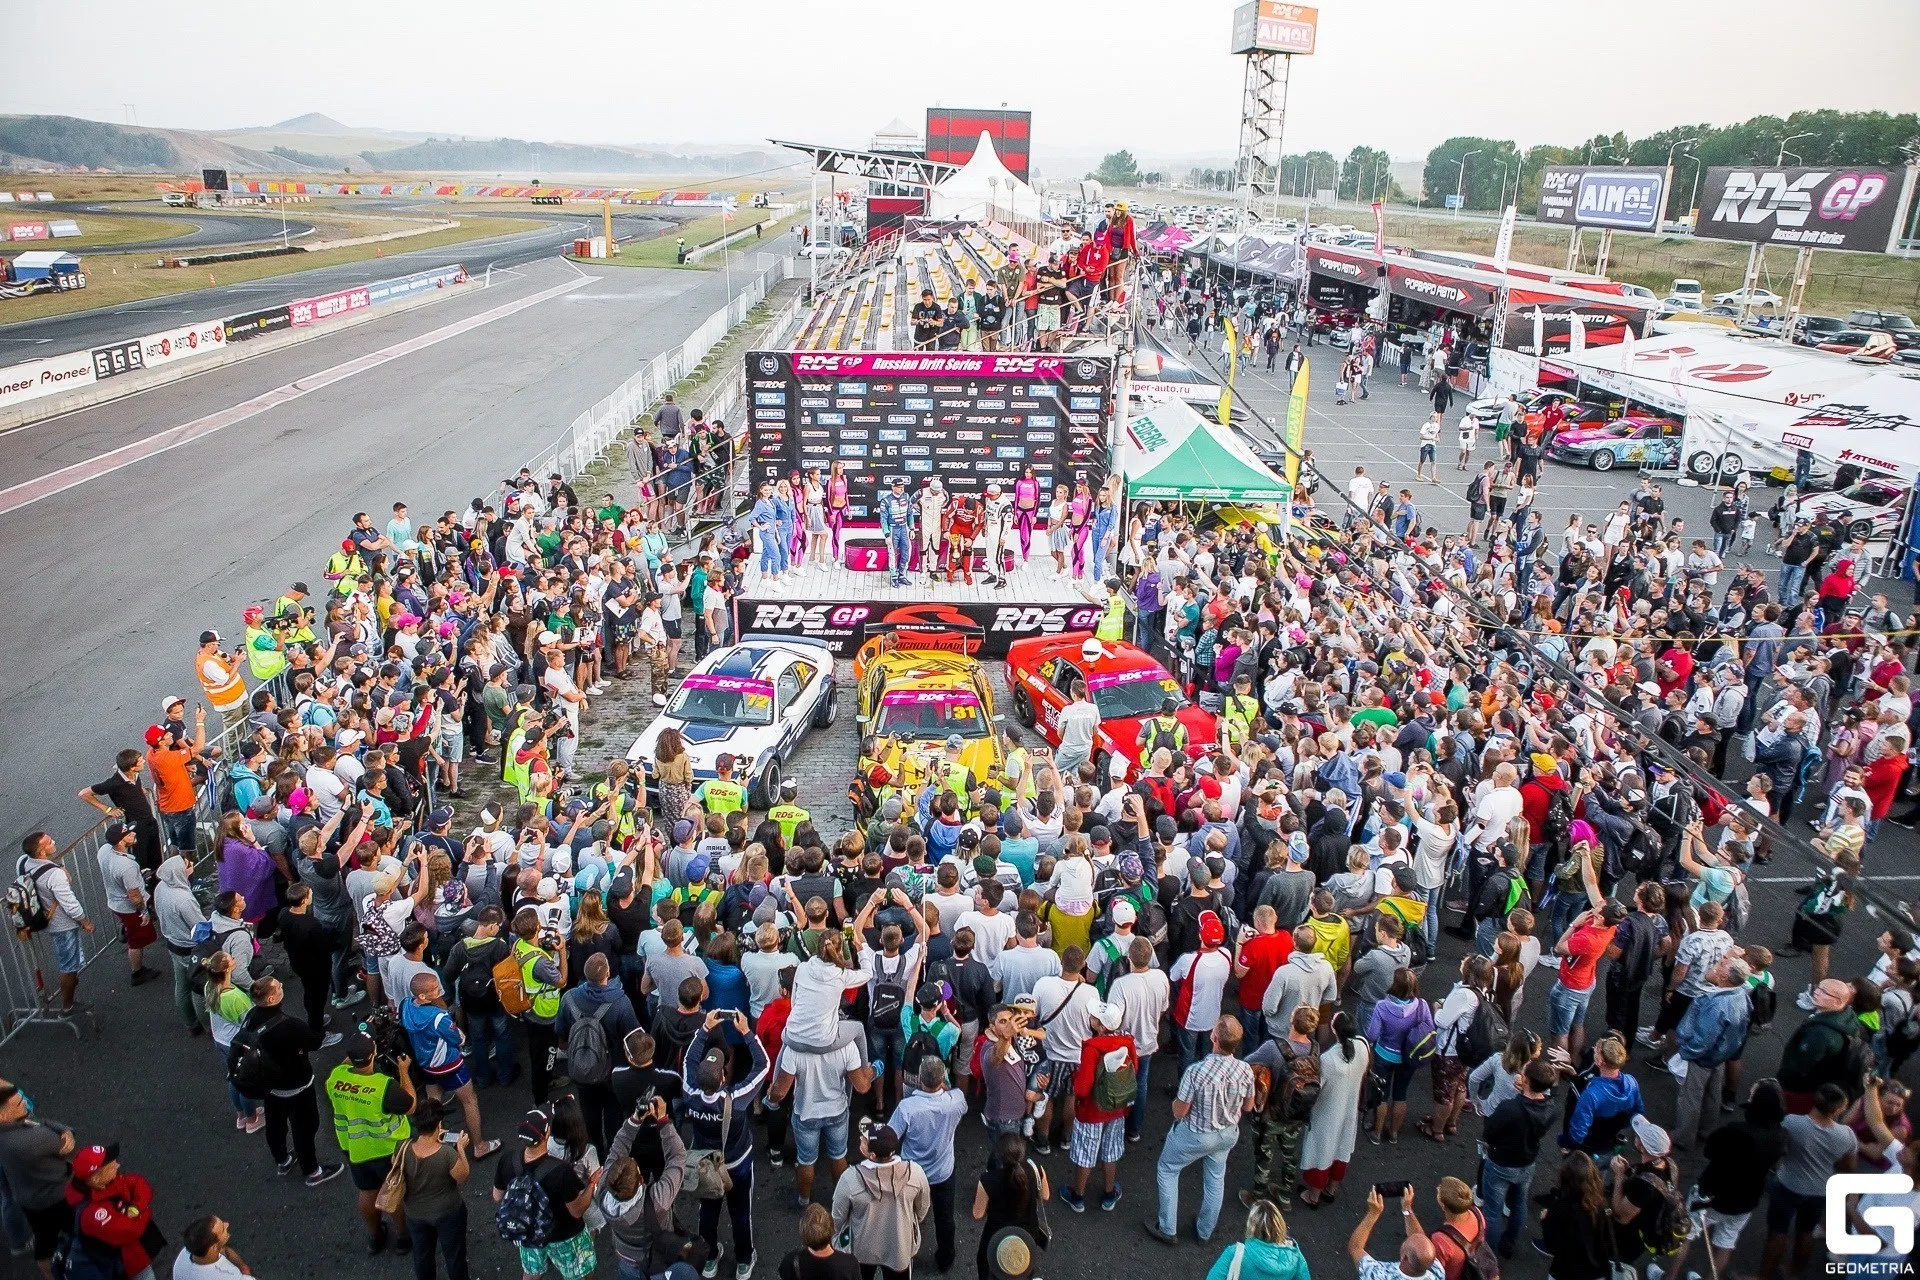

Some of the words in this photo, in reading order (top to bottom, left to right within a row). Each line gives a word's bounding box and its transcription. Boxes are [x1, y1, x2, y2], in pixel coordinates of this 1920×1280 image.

[1260, 23, 1309, 44] AIMOL
[1543, 172, 1570, 189] RDS
[1580, 184, 1653, 215] AIMOL
[1712, 172, 1832, 226] RDS
[1821, 176, 1885, 216] GP
[1771, 228, 1801, 241] Russian
[1819, 231, 1846, 244] Series
[1405, 277, 1436, 295] ФОРВАРД
[1436, 285, 1457, 300] АВТО
[797, 356, 843, 370] RDS
[872, 358, 919, 370] Russian
[918, 358, 946, 370] Drift
[945, 358, 983, 371] Series
[993, 358, 1039, 372] RDS
[0, 379, 33, 394] neer
[40, 366, 91, 384] Pioneer
[1130, 383, 1190, 394] iper-auto.ru
[1783, 433, 1811, 447] MOTUL
[1852, 454, 1899, 471] ATOMIC
[866, 550, 878, 568] 2
[751, 605, 833, 628] RDS
[832, 607, 869, 625] GP
[991, 608, 1074, 631] RDS
[1118, 671, 1143, 682] RDS
[747, 694, 770, 709] 12
[917, 693, 947, 701] RDS
[953, 705, 977, 719] 31
[710, 788, 728, 796] RDS
[334, 1080, 362, 1094] RDS
[362, 1086, 376, 1094] GP
[689, 1108, 730, 1122] FRANC
